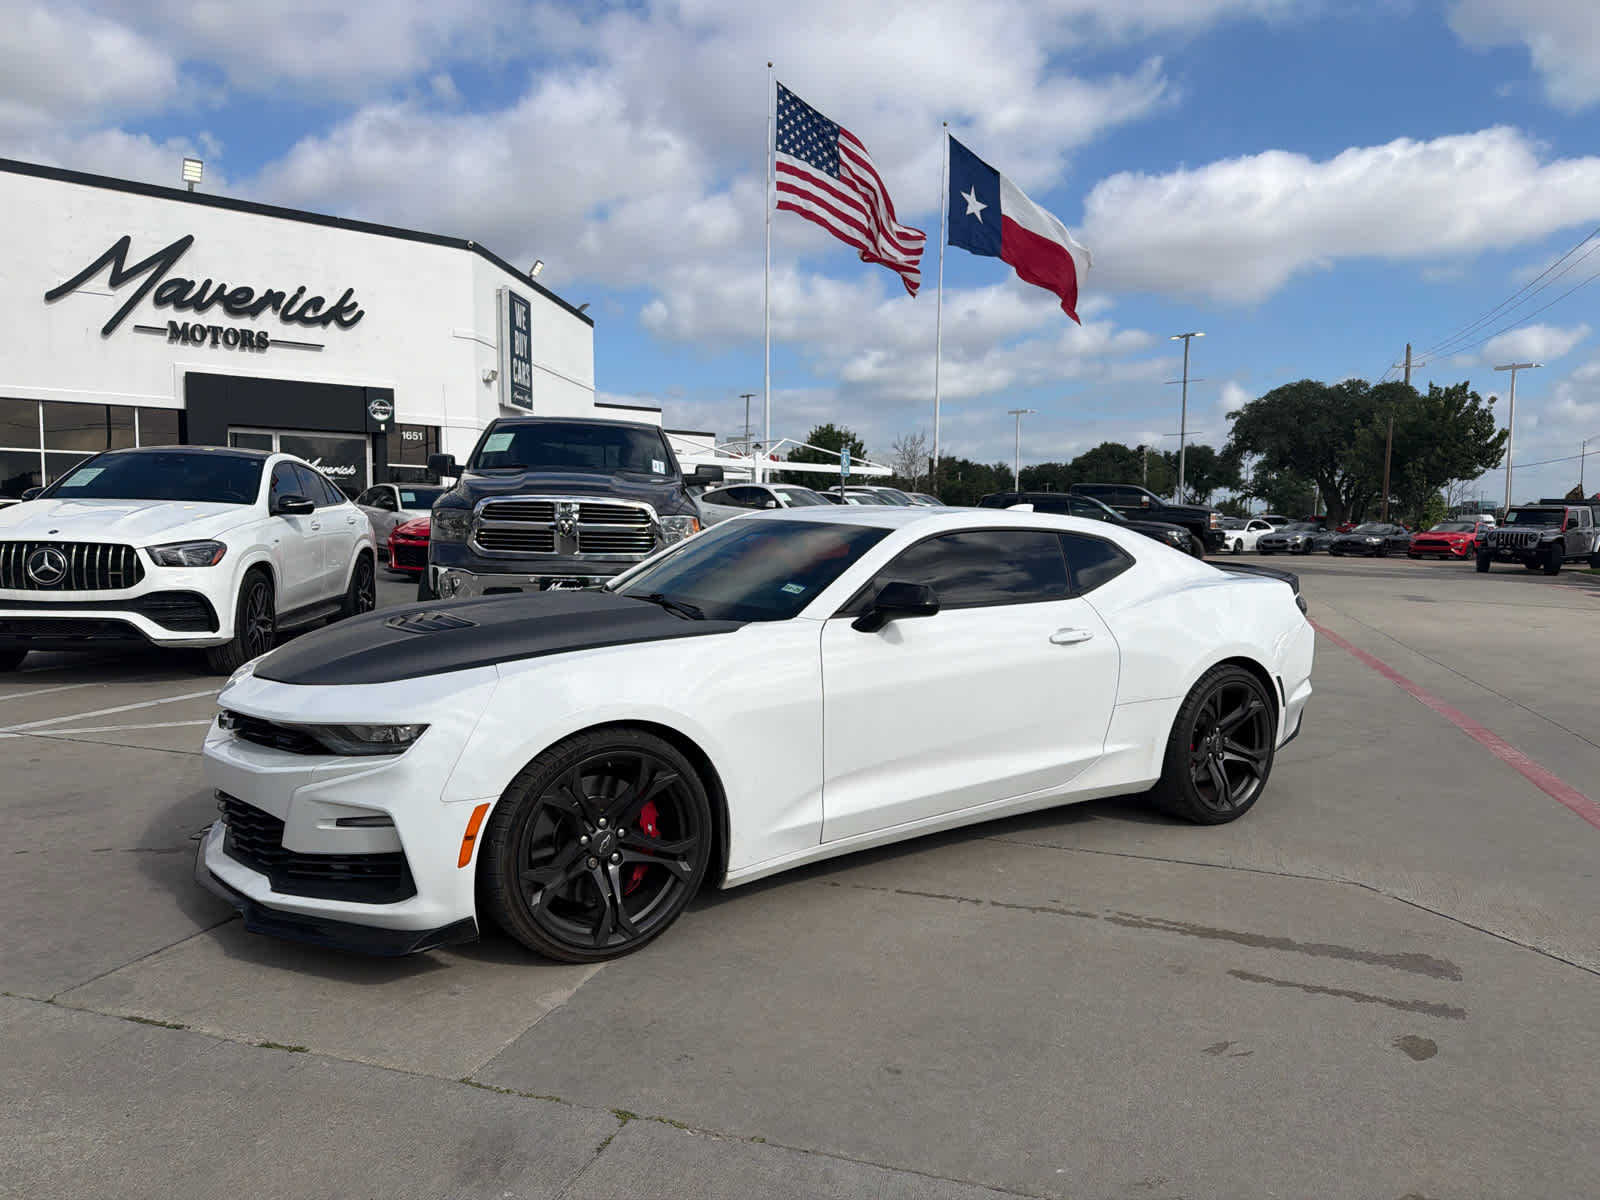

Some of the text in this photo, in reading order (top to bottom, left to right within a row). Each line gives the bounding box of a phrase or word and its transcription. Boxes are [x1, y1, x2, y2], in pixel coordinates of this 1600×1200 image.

[44, 234, 365, 337] Maverick
[514, 301, 527, 330] WE
[167, 320, 270, 350] MOTORS
[514, 330, 528, 359] BUY
[512, 357, 530, 388] CARS
[402, 431, 423, 441] 1651
